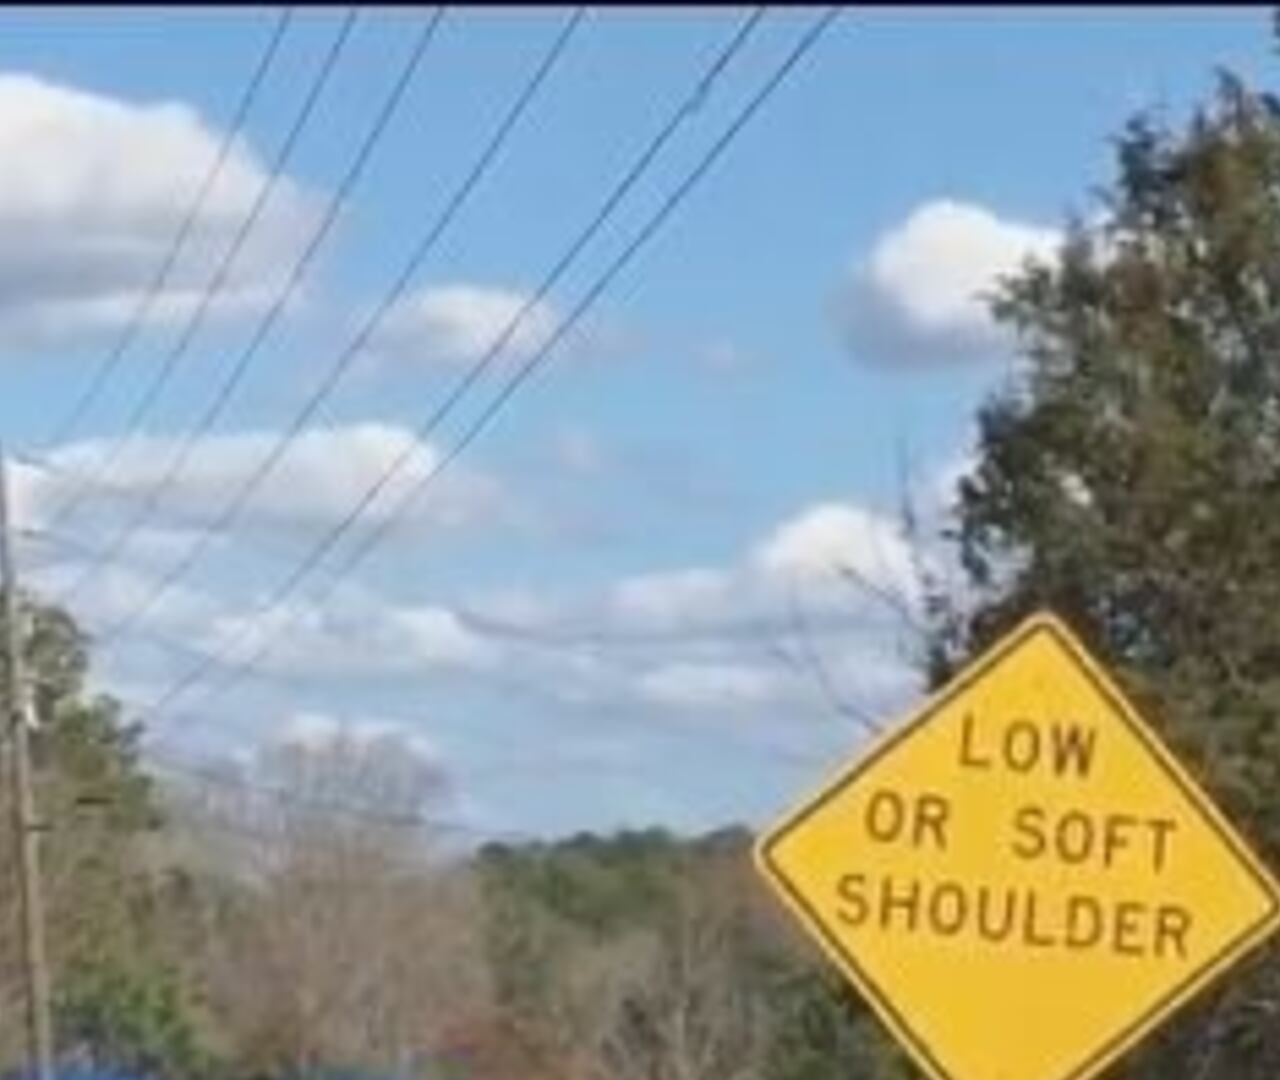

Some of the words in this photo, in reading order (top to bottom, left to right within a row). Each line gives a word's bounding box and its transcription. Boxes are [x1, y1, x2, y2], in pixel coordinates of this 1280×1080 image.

[958, 713, 1097, 779] LOW
[863, 789, 951, 850] OR
[1010, 806, 1178, 874] SOFT
[835, 873, 1192, 960] SHOULDER
